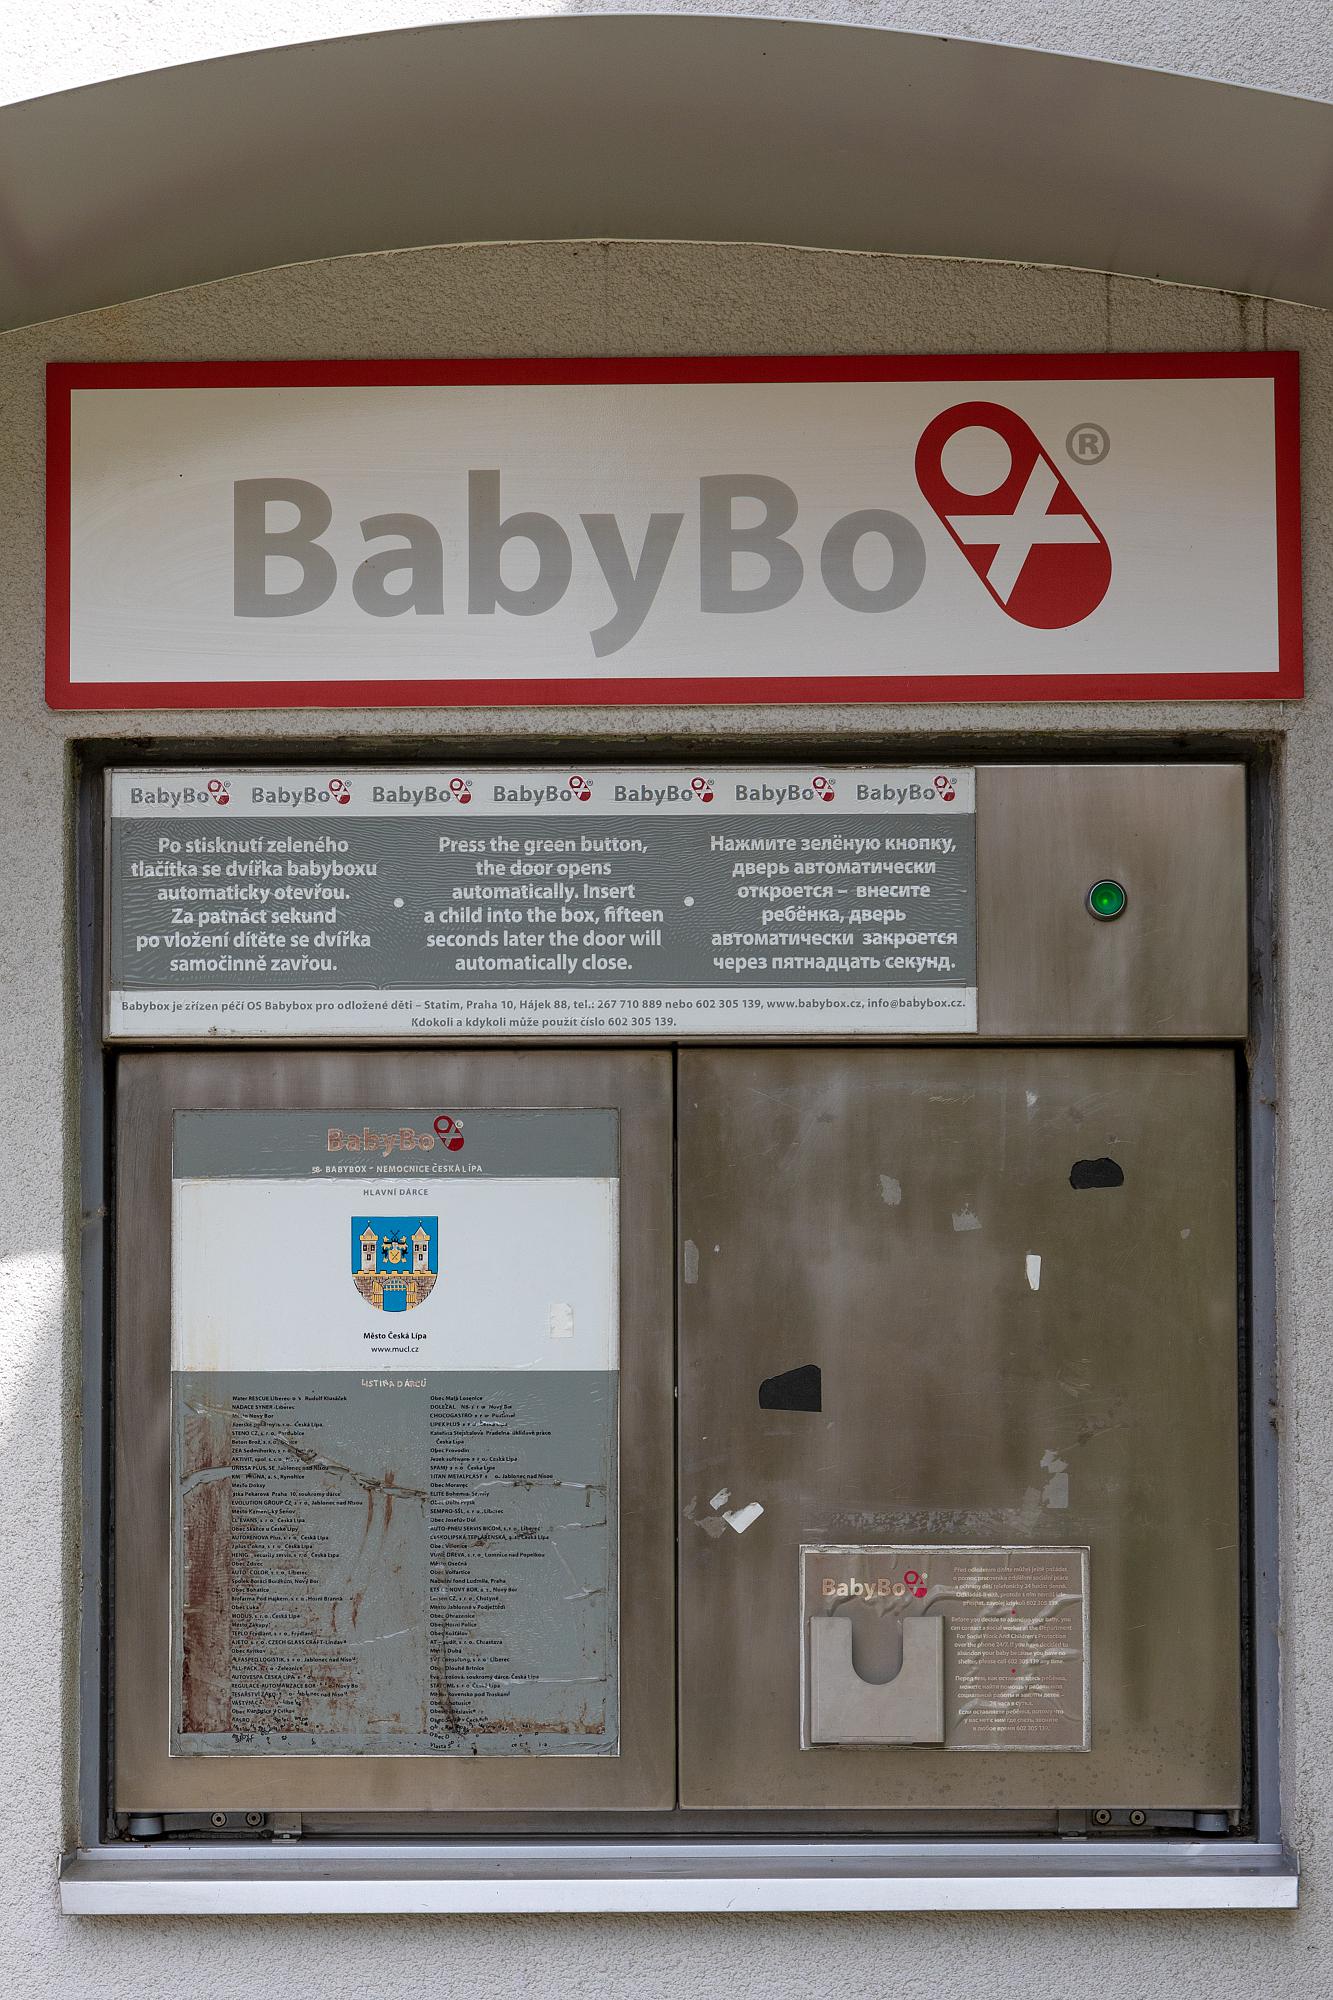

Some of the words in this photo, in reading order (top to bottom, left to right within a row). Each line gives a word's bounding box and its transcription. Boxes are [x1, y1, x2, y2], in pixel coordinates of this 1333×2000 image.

[159, 838, 182, 853] Po
[186, 836, 264, 853] stisknutí
[267, 836, 349, 853] zeleného
[439, 837, 486, 852] Press
[490, 836, 520, 852] the
[524, 840, 576, 856] green
[581, 836, 648, 853] button,
[711, 836, 796, 851] Нажмите
[801, 834, 881, 854] зелёную
[885, 838, 956, 854] кнопку,
[131, 860, 198, 878] tlačítka
[202, 865, 221, 877] se
[226, 859, 282, 876] dvířka
[287, 860, 377, 880] babyboxu
[475, 860, 506, 875] the
[510, 859, 553, 875] door
[557, 863, 611, 879] opens
[732, 862, 789, 878] дверь
[794, 862, 936, 874] автоматически
[158, 883, 271, 904] automaticky
[274, 883, 351, 899] otevřou.
[452, 883, 579, 903] automatically.
[584, 884, 635, 898] Insert
[737, 885, 833, 901] откроется
[856, 885, 930, 897] внесите
[171, 908, 194, 923] Za
[199, 908, 267, 927] patnáct
[271, 907, 336, 923] sekund
[424, 911, 434, 923] a
[439, 907, 482, 923] child
[487, 907, 522, 923] into
[526, 907, 556, 922] the
[561, 906, 600, 924] box,
[604, 906, 663, 922] fifteen
[762, 905, 844, 925] ребёнка,
[849, 909, 906, 925] дверь
[137, 936, 160, 951] po
[163, 931, 229, 948] vložení
[233, 931, 286, 947] dítěte
[290, 935, 309, 947] se
[314, 930, 371, 947] dvířka
[427, 930, 499, 947] seconds
[504, 930, 545, 946] later
[549, 930, 578, 946] the
[583, 930, 626, 946] door
[630, 930, 661, 946] will
[712, 933, 853, 945] автоматически
[862, 933, 957, 948] закроется
[170, 955, 267, 971] samočinně
[271, 955, 337, 971] zavřou.
[455, 954, 578, 974] automatically
[582, 954, 632, 970] close.
[713, 957, 767, 973] через
[772, 957, 880, 972] пятнадцать
[885, 957, 955, 972] секунд.
[122, 1001, 169, 1013] Babybox
[172, 1001, 182, 1012] je
[185, 1001, 218, 1010] zřízen
[222, 1001, 244, 1012] péčí
[247, 1001, 262, 1010] OS
[265, 1001, 312, 1012] Babybox
[316, 1003, 334, 1012] pro
[337, 1001, 388, 1010] odložené
[391, 1000, 412, 1009] děti
[424, 1000, 463, 1010] Statim,
[467, 1000, 497, 1009] Praha
[501, 1000, 516, 1010] 10,
[520, 1000, 551, 1011] Hájek
[554, 1000, 570, 1010] 88,
[573, 1000, 594, 1009] tel.:
[597, 1000, 617, 1009] 267
[620, 1000, 639, 1008] 710
[642, 1000, 662, 1008] 889
[665, 999, 693, 1009] nebo
[696, 1000, 715, 1008] 602
[719, 1000, 738, 1008] 305
[742, 999, 763, 1009] 139,
[767, 998, 864, 1010] www.babybox.cz,
[868, 997, 965, 1010] info@babybox.cz.
[412, 1017, 453, 1027] Kdokoli
[466, 1017, 506, 1029] kdykoli
[509, 1017, 539, 1026] může
[542, 1017, 577, 1028] použít
[580, 1017, 605, 1026] číslo
[608, 1017, 628, 1026] 602
[631, 1017, 651, 1026] 305
[655, 1017, 676, 1026] 139.
[325, 1165, 367, 1173] BABYBOX
[376, 1165, 430, 1173] NEMOCNICE
[363, 1187, 397, 1196] HLAVNÍ
[399, 1187, 429, 1196] DÁRCE
[363, 1332, 386, 1340] Město
[387, 1330, 410, 1340] Česká
[411, 1332, 427, 1340] Lípa
